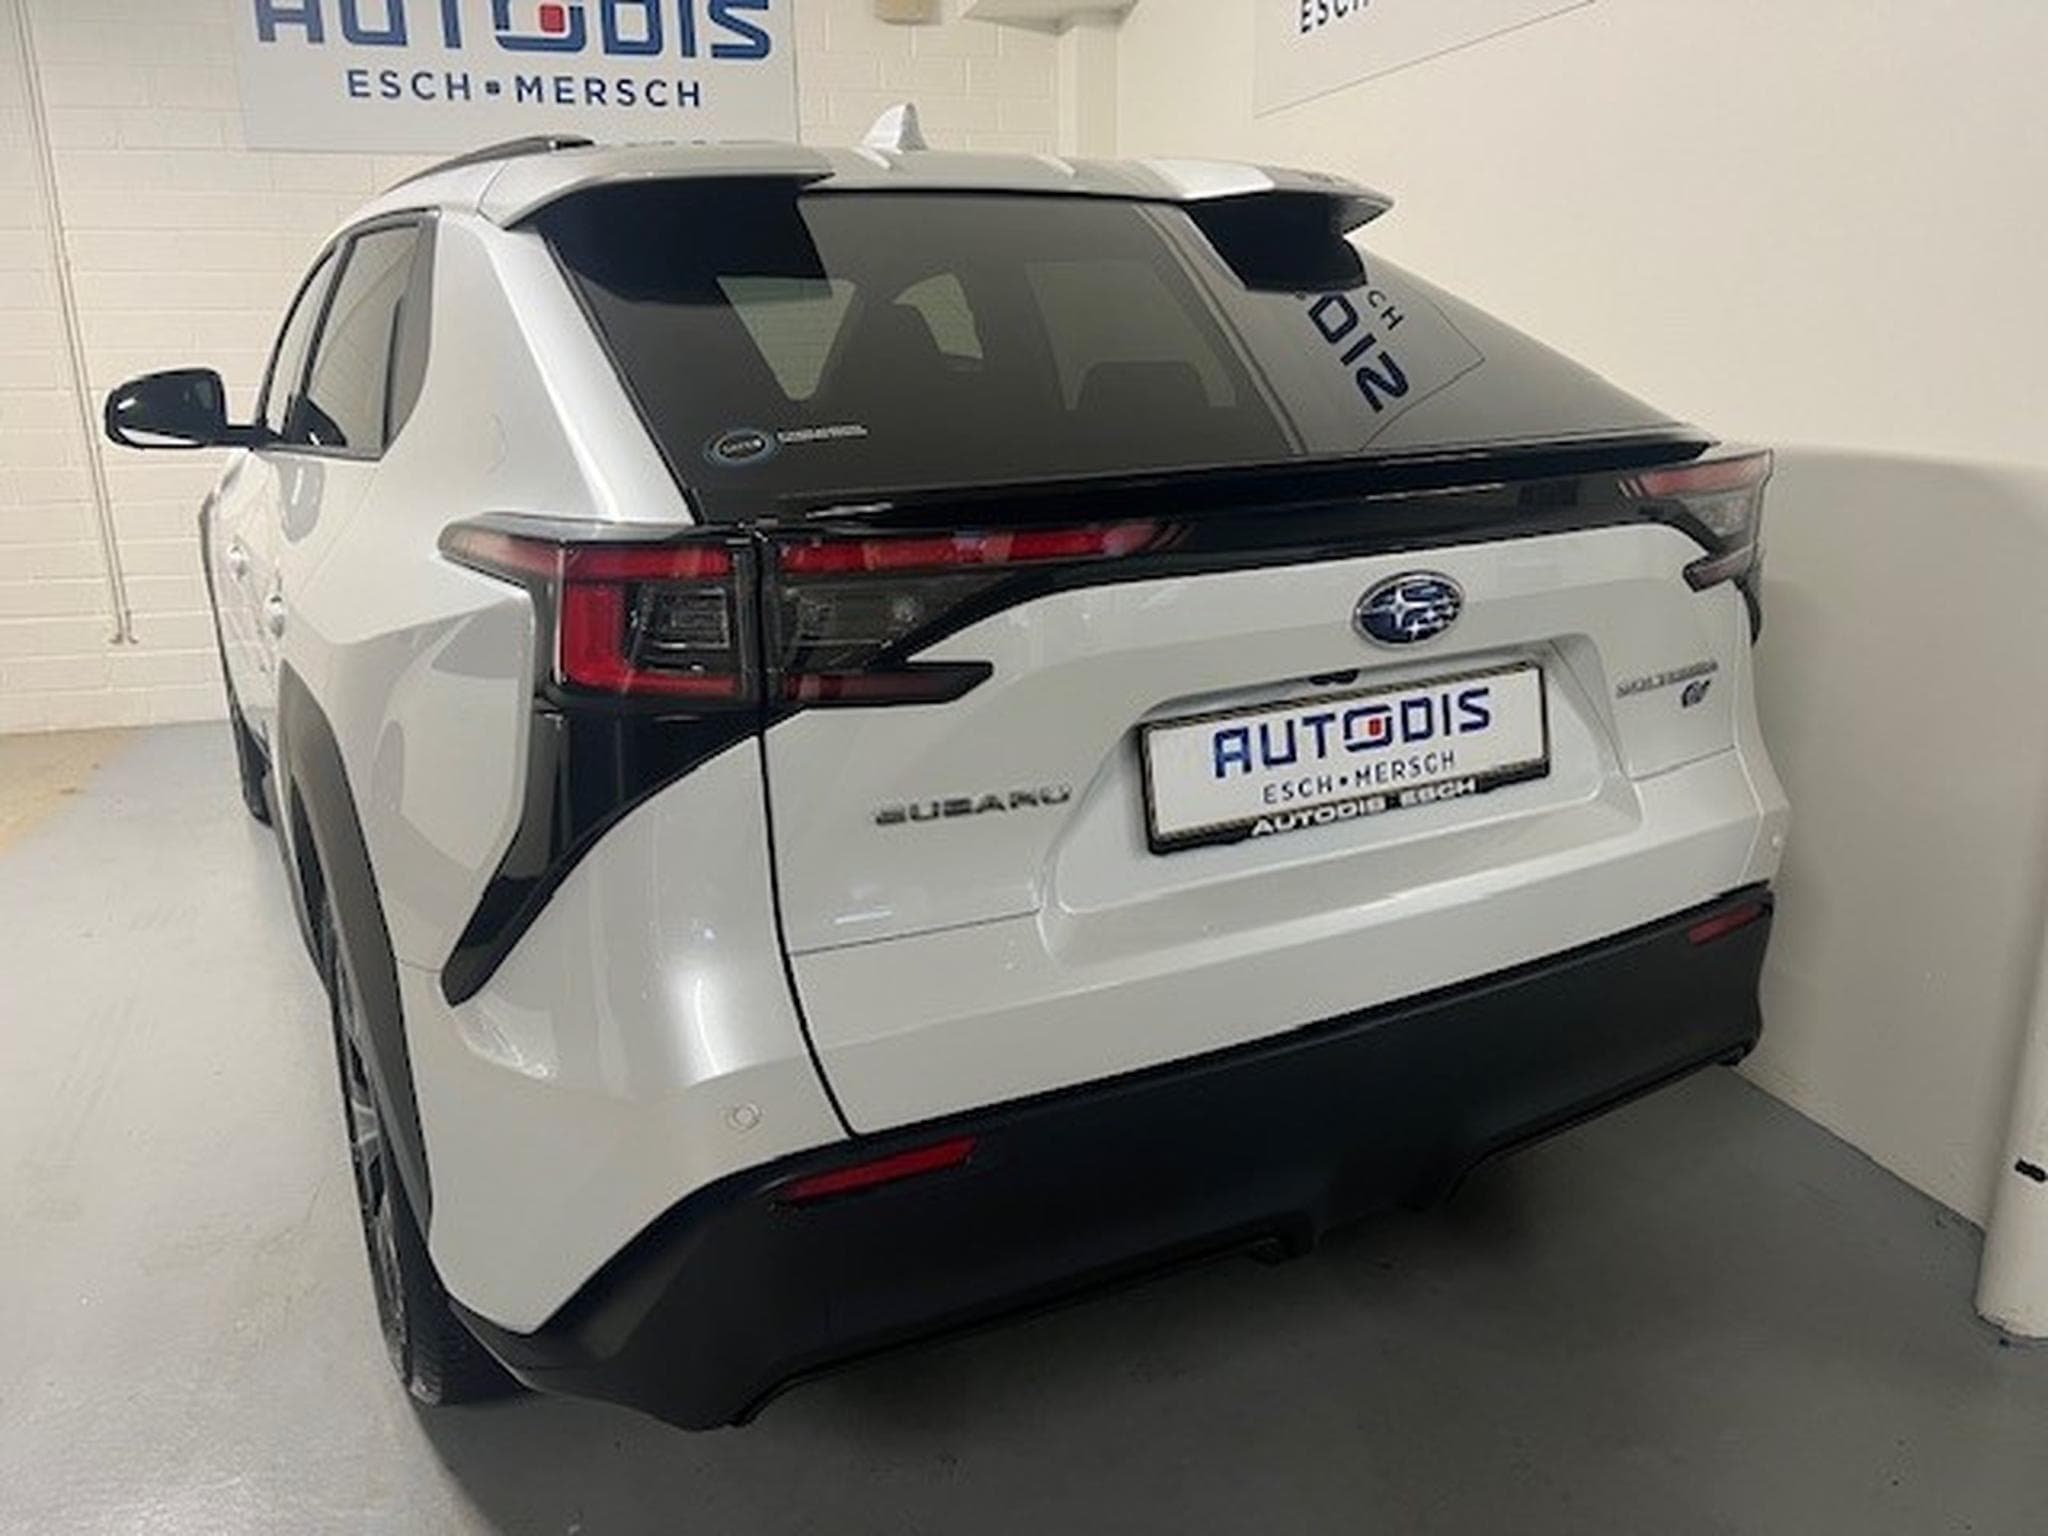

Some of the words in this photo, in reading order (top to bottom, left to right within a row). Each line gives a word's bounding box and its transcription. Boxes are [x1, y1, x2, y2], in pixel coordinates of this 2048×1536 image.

[256, 0, 773, 60] AUTODIS
[346, 69, 471, 100] ESCH
[516, 74, 701, 107] MERSCH
[1213, 687, 1491, 779] AUTODIS
[875, 783, 1071, 826] SUBARU
[1263, 774, 1333, 805] ESCH
[1354, 750, 1456, 787] MERSCH
[1251, 796, 1387, 837] AUTODIS
[1400, 778, 1477, 810] ESCH
